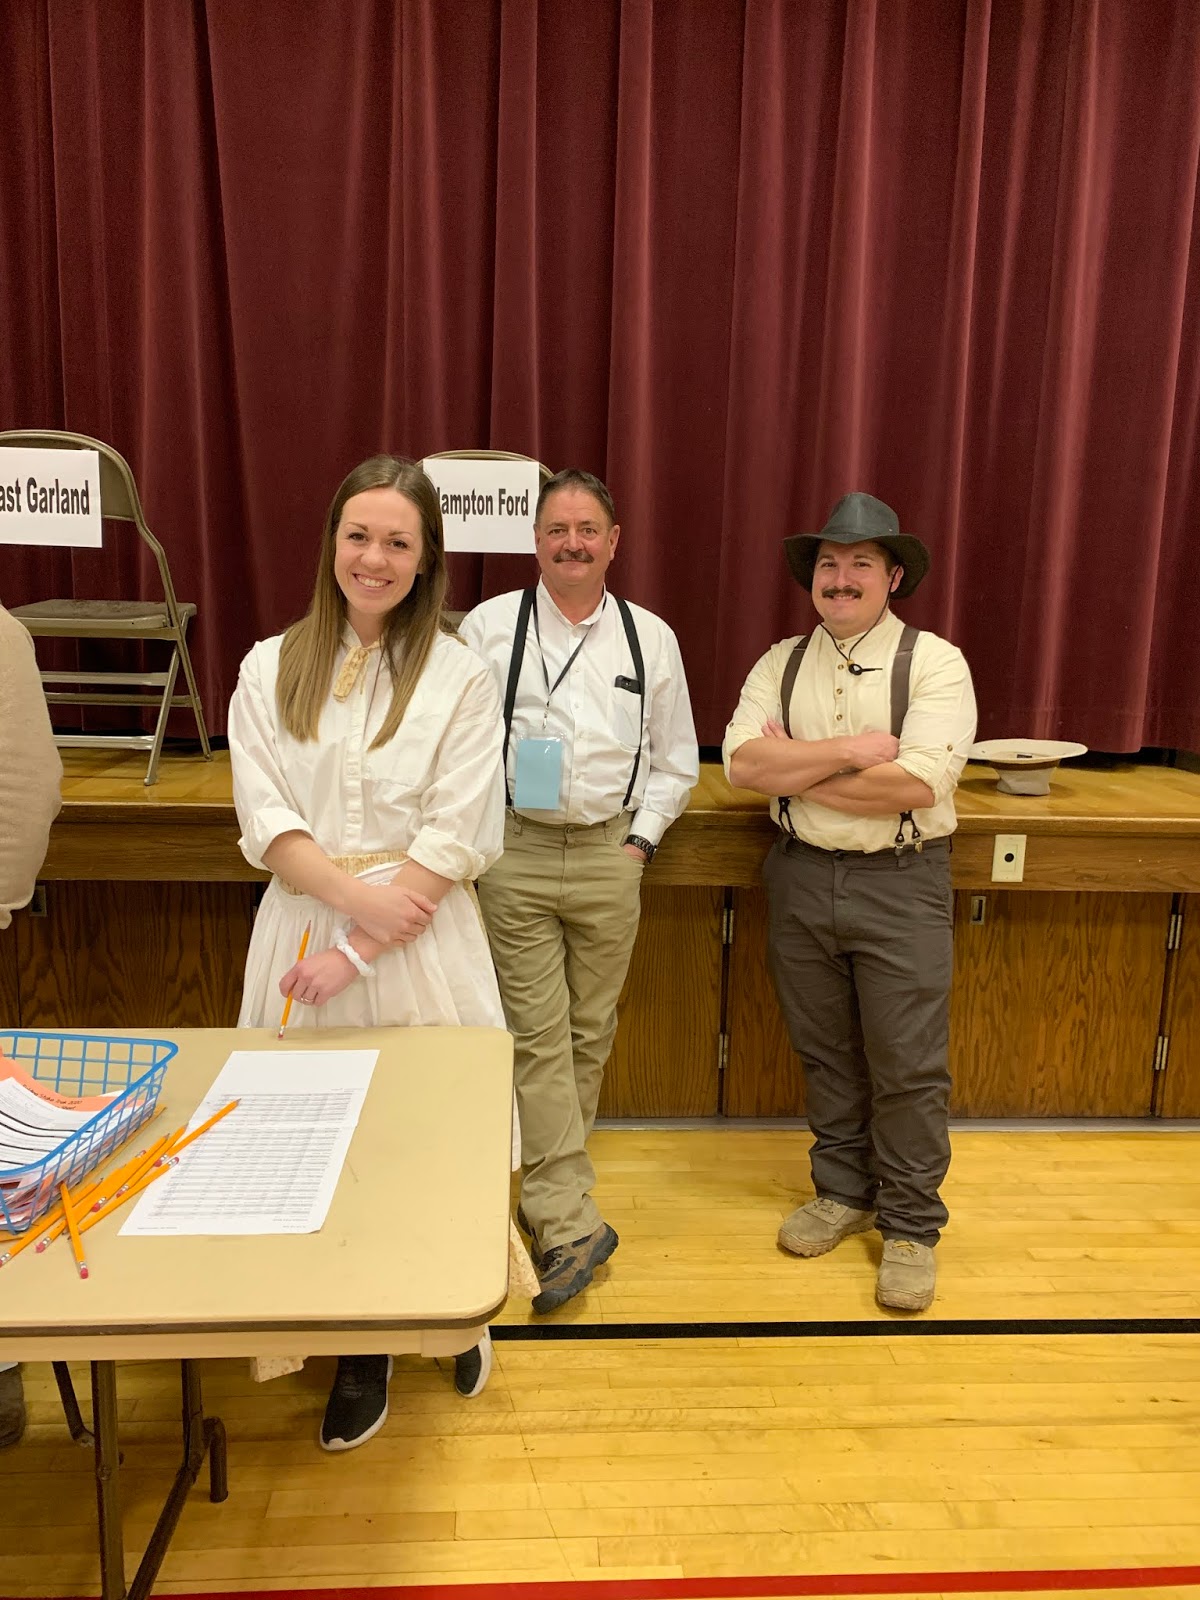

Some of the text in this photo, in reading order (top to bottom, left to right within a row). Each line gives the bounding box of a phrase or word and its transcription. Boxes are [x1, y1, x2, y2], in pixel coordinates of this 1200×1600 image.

[26, 476, 91, 516] Garland
[436, 486, 529, 522] ampton Ford
